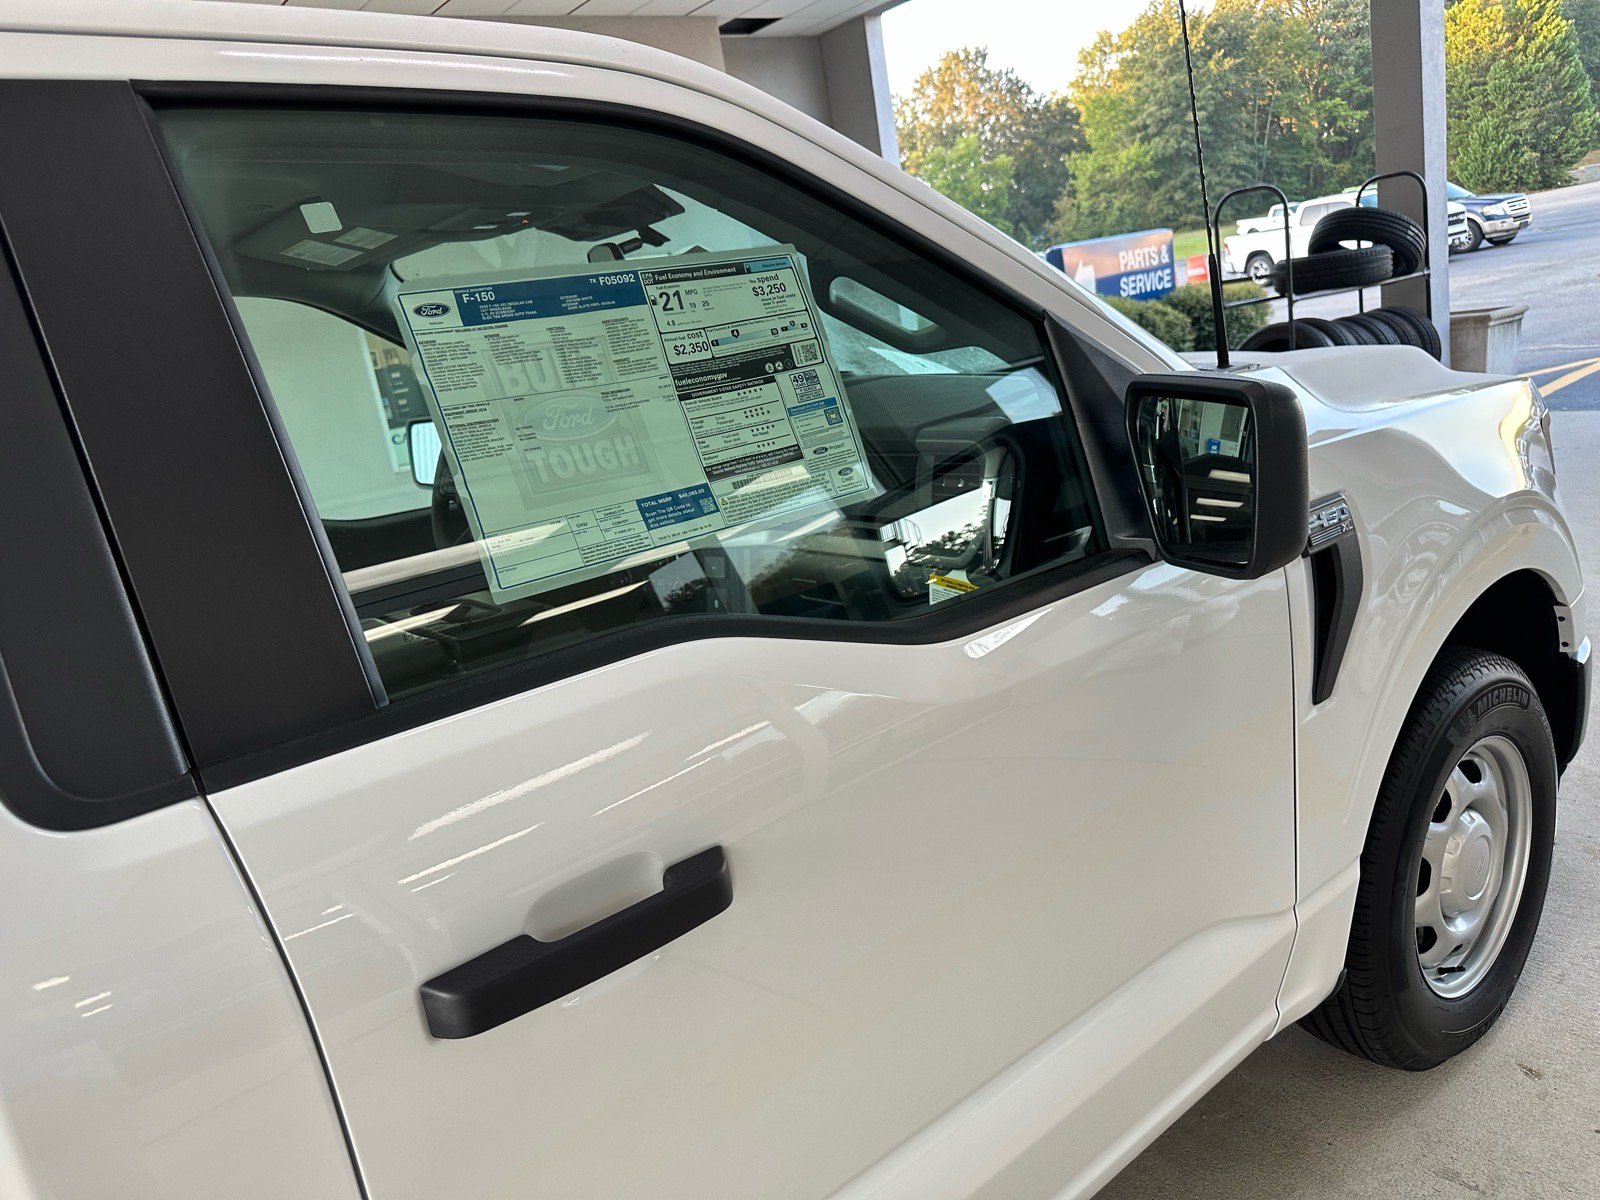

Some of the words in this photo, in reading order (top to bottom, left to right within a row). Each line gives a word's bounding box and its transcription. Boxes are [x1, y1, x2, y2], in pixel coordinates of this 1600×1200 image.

[1119, 246, 1159, 272] PARTS
[1160, 244, 1169, 264] &
[598, 273, 636, 286] F05092
[656, 272, 668, 280] Fuel
[668, 271, 692, 280] Economy
[704, 267, 736, 276] Environment
[757, 273, 779, 284] spend
[752, 282, 787, 298] $3,250
[1120, 268, 1172, 298] SERVICE
[462, 292, 496, 304] F-150
[659, 290, 684, 312] 21
[687, 331, 703, 339] cost
[673, 341, 709, 356] $2,350
[792, 374, 804, 383] 49
[692, 388, 718, 397] GOVERNMENT
[543, 402, 596, 432] Ford
[527, 435, 640, 484] TOUGH
[1477, 687, 1531, 715] MICHELIN
